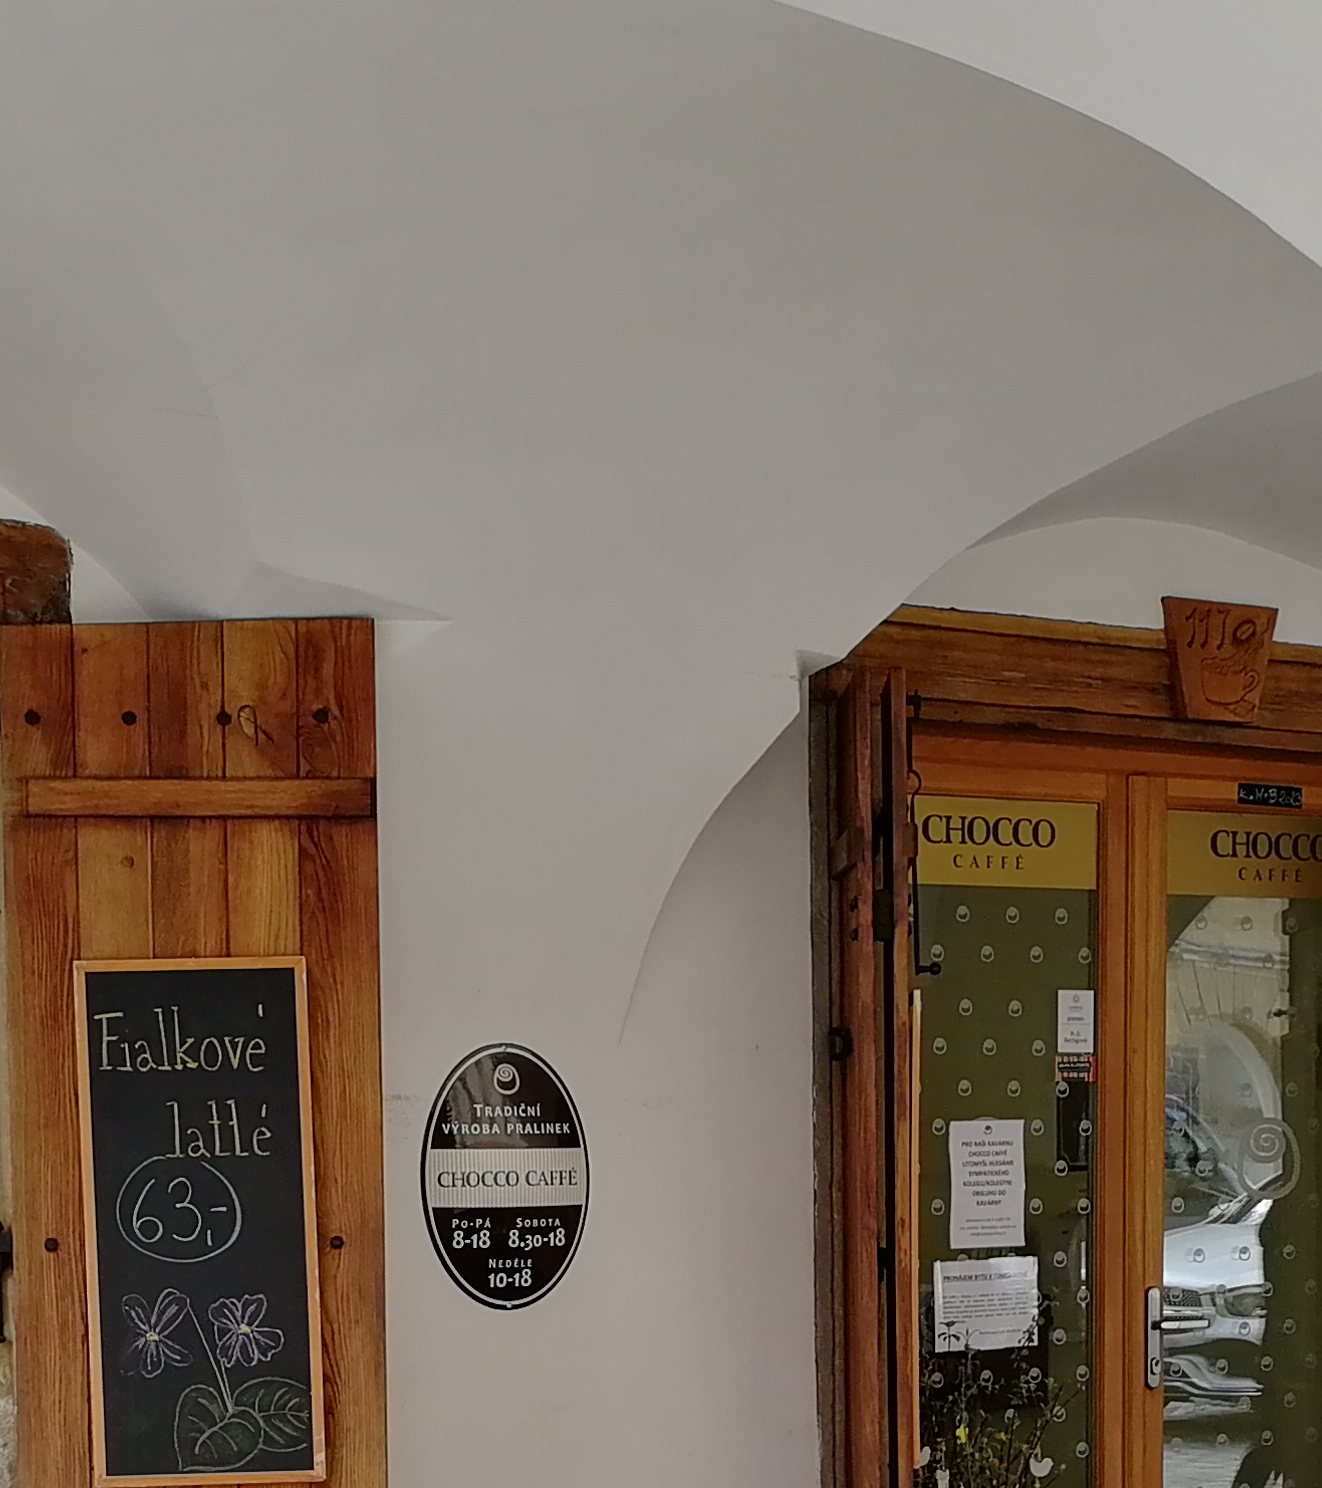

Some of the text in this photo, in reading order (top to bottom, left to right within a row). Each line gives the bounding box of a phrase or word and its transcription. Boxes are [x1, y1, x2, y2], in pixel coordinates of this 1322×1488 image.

[921, 813, 1057, 849] CHOCCO
[952, 853, 1026, 872] CAFFÉ
[1237, 864, 1304, 884] CAFFÉ
[93, 1003, 268, 1072] Fialkové
[441, 1120, 571, 1136] VÝROBA PRALINEK
[437, 1167, 578, 1188] CHOCCO CAFFÉ
[452, 1227, 566, 1251] 8-18 8.30-18
[487, 1269, 533, 1288] 10-18
